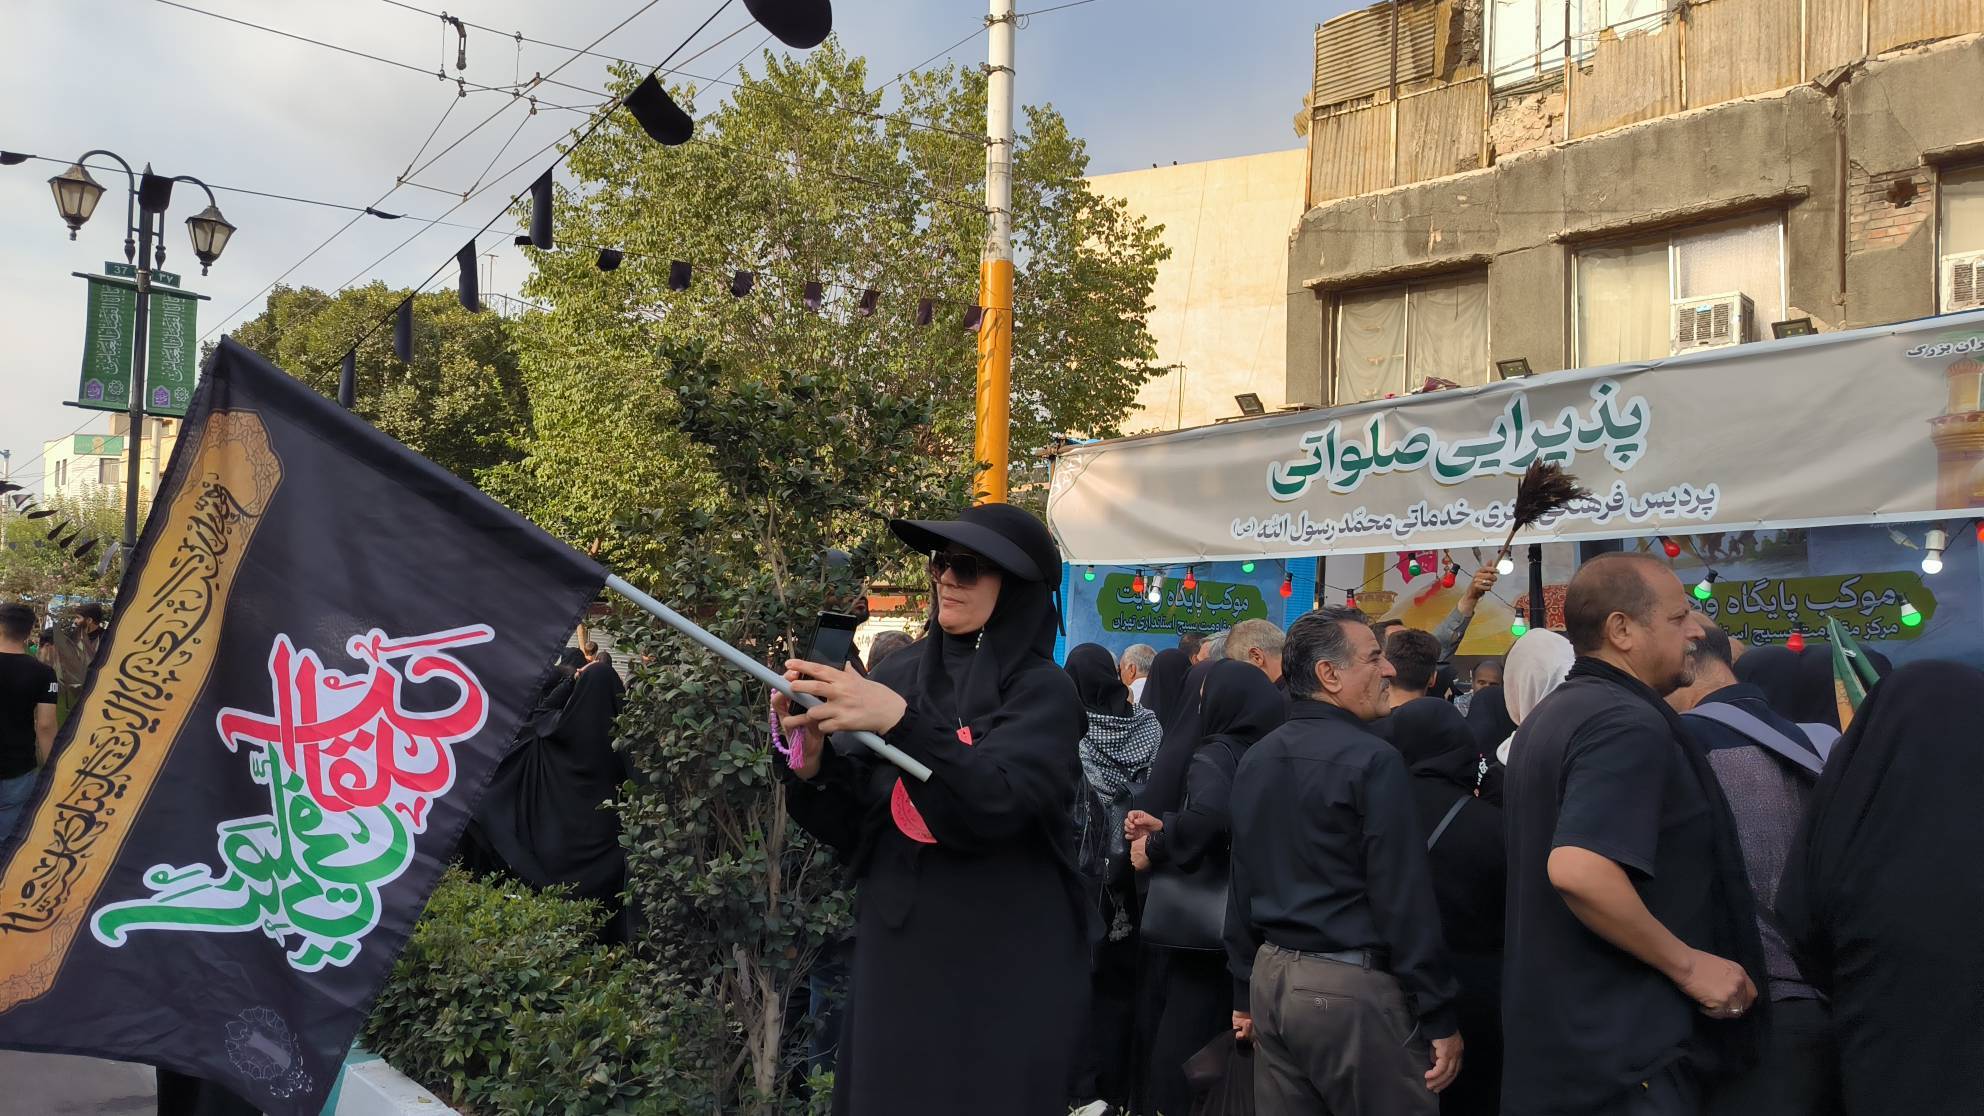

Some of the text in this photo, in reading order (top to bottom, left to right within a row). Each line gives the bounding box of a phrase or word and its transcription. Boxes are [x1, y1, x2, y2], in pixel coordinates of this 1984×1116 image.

[114, 265, 128, 274] 37
[159, 273, 173, 282] ۳۷
[1907, 338, 1984, 357] ران بزرگ
[1272, 382, 1643, 495] پذیرایی صلواتی
[1629, 486, 1715, 518] پردیس
[1290, 513, 1335, 542] رسول
[1395, 502, 1471, 536] خدماتی
[1167, 583, 1203, 618] پایگاه
[1206, 585, 1250, 618] موکب
[1727, 578, 1798, 622] پایگاه
[1805, 575, 1897, 617] موکب
[1112, 612, 1137, 630] تهران
[1137, 615, 1176, 632] استانداری
[1176, 619, 1198, 636] بسیج
[1800, 622, 1860, 642] مقمت
[1863, 618, 1899, 641] مرکز
[1752, 628, 1794, 646] سیج
